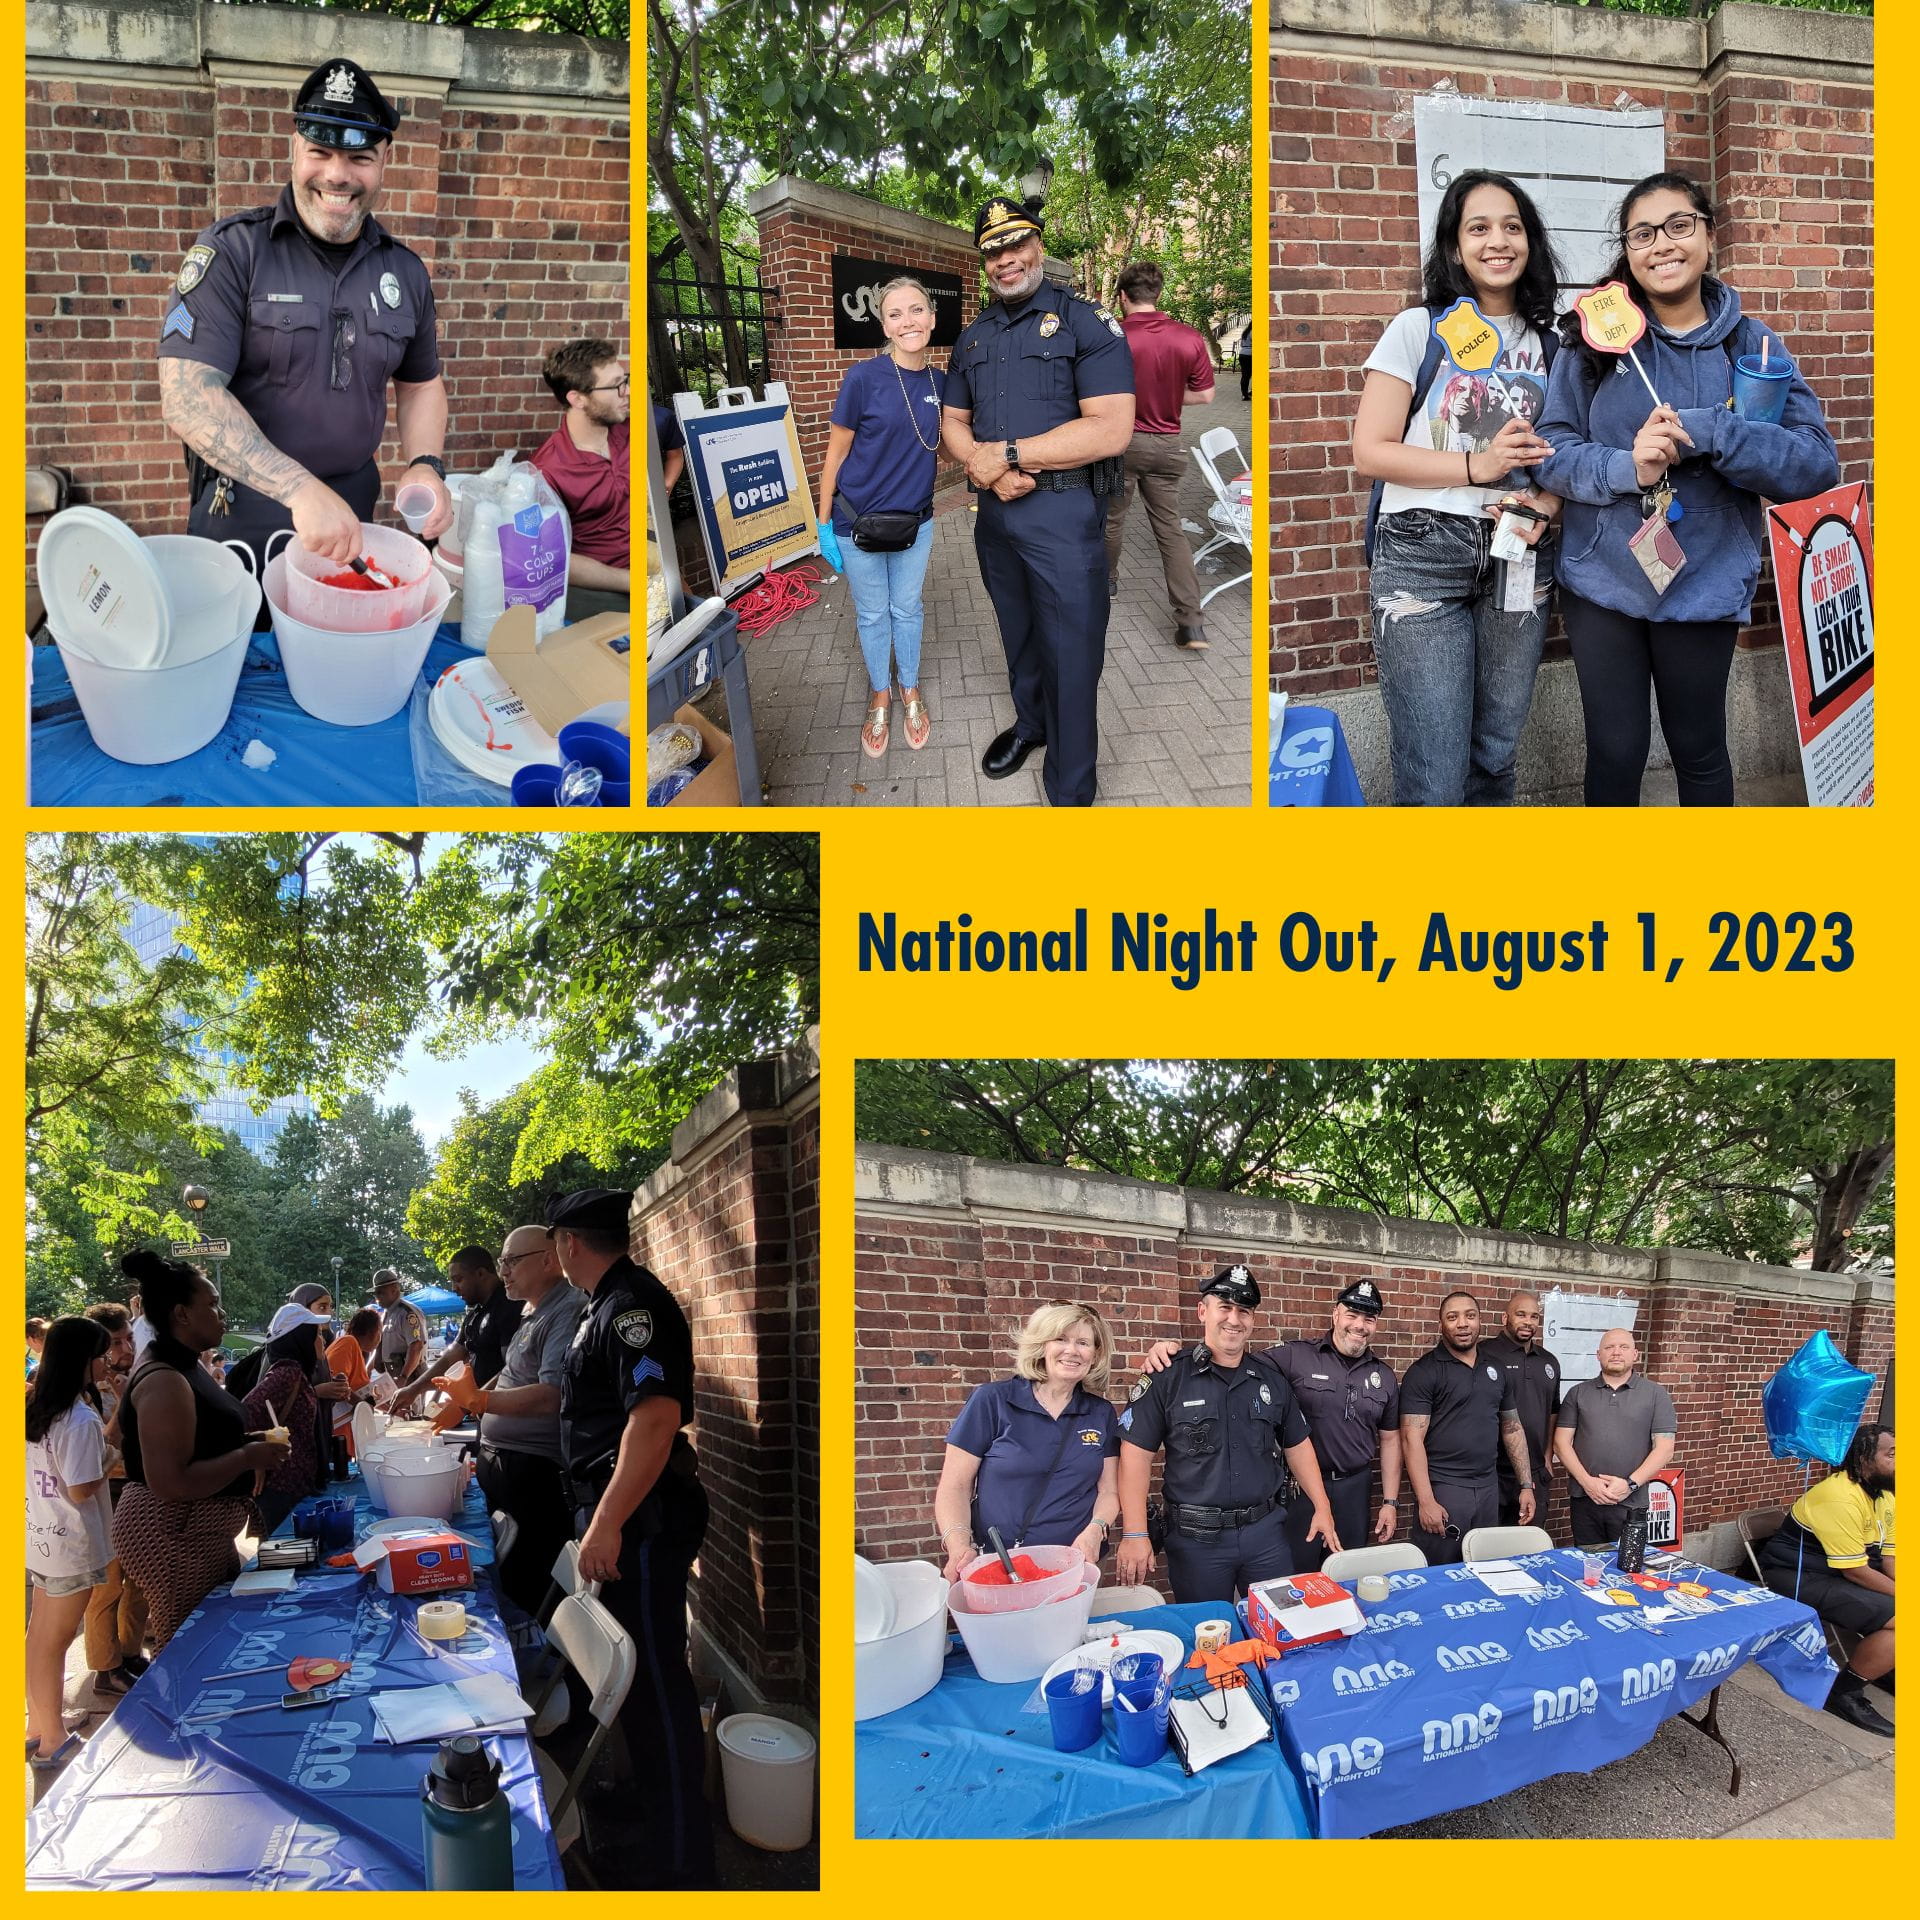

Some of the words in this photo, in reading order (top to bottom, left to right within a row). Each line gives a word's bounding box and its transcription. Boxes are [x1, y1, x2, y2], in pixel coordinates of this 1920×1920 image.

[1431, 154, 1452, 190] 6
[926, 288, 958, 296] NIVERSITY
[1593, 295, 1616, 312] FIRE
[1605, 324, 1628, 342] DEPT
[1456, 330, 1490, 360] POLICE
[729, 466, 738, 474] The
[738, 460, 757, 472] Rush
[734, 480, 784, 510] OPEN
[524, 551, 554, 570] COLD
[1812, 554, 1823, 578] BE
[1824, 540, 1852, 572] SMART
[526, 564, 554, 582] CUPS
[1810, 576, 1828, 606] NOT
[1830, 562, 1858, 594] SORRY:
[89, 581, 111, 613] LEMON
[1814, 598, 1840, 632] LOCK
[1838, 584, 1862, 616] YOUR
[1818, 608, 1868, 683] BIKE
[506, 706, 525, 716] FISH
[174, 1246, 208, 1255] LANCASTER
[618, 1316, 649, 1330] POLICE
[1548, 1320, 1556, 1338] 6
[1650, 1492, 1669, 1501] SMART
[1656, 1511, 1670, 1520] YOUR
[1649, 1521, 1670, 1540] IKE
[1445, 1662, 1480, 1672] NATIONAL
[1480, 1659, 1502, 1668] NIGHT
[1336, 1686, 1378, 1696] NATIONAL
[1622, 1694, 1650, 1707] NATIONAL
[1532, 1716, 1564, 1732] NATIONAL
[1581, 1706, 1596, 1714] OUT
[750, 1737, 776, 1746] MANGO
[1422, 1746, 1464, 1763] NATIONAL
[1464, 1739, 1485, 1754] NIGHT
[1484, 1732, 1500, 1744] OUT
[1334, 1772, 1362, 1784] NIGHT
[1364, 1766, 1382, 1777] OUT
